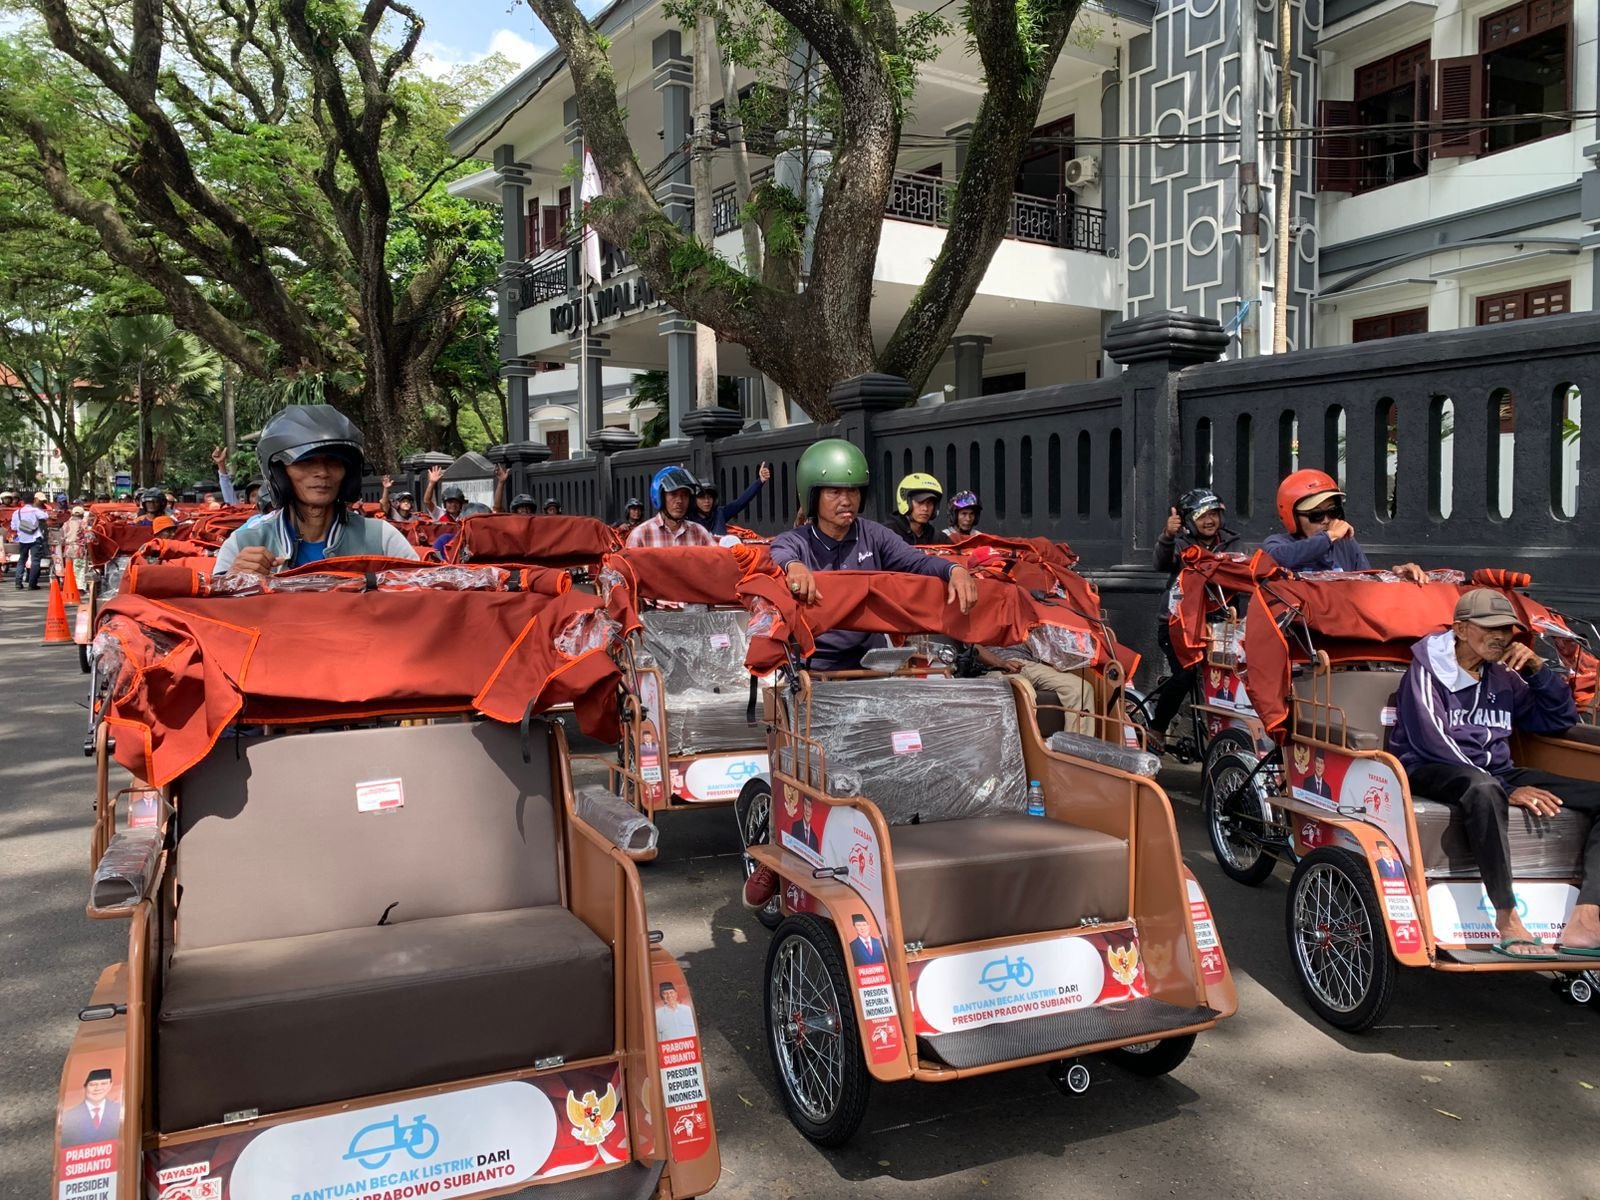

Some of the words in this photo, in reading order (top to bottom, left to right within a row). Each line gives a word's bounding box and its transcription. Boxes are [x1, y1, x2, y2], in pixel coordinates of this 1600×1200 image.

[597, 275, 660, 323] MALA
[1449, 707, 1512, 731] STRALIA
[1532, 931, 1562, 939] SUBIAN
[863, 987, 888, 998] PRESIDEN
[953, 998, 996, 1014] BANTUAN
[997, 993, 1025, 1006] BECAK
[1026, 987, 1057, 1001] LISTRIK
[1058, 983, 1079, 995] DARI
[865, 996, 890, 1007] REPUBLIK
[952, 1009, 994, 1025] PRESIDEN
[994, 1002, 1040, 1017] PRABOWO
[1040, 994, 1083, 1009] SUBIANTO
[865, 1006, 893, 1017] INDONESIA
[661, 1039, 695, 1054] PRABOWO
[663, 1051, 696, 1065] SUBIANTO
[666, 1066, 698, 1080] PRESIDEN
[668, 1078, 700, 1092] REPUBLIK
[668, 1089, 703, 1104] INDONESIA
[65, 1144, 113, 1162] PRABOWO
[65, 1158, 112, 1176] SUBIANTO
[159, 1164, 207, 1181] YAYASAN
[370, 1168, 420, 1190] BECAK
[423, 1156, 475, 1179] LISTRIK
[477, 1149, 510, 1167] DARI
[443, 1164, 516, 1190] SUBIANTO
[65, 1177, 110, 1195] PRESIDEN
[65, 1190, 110, 1200] BLIK
